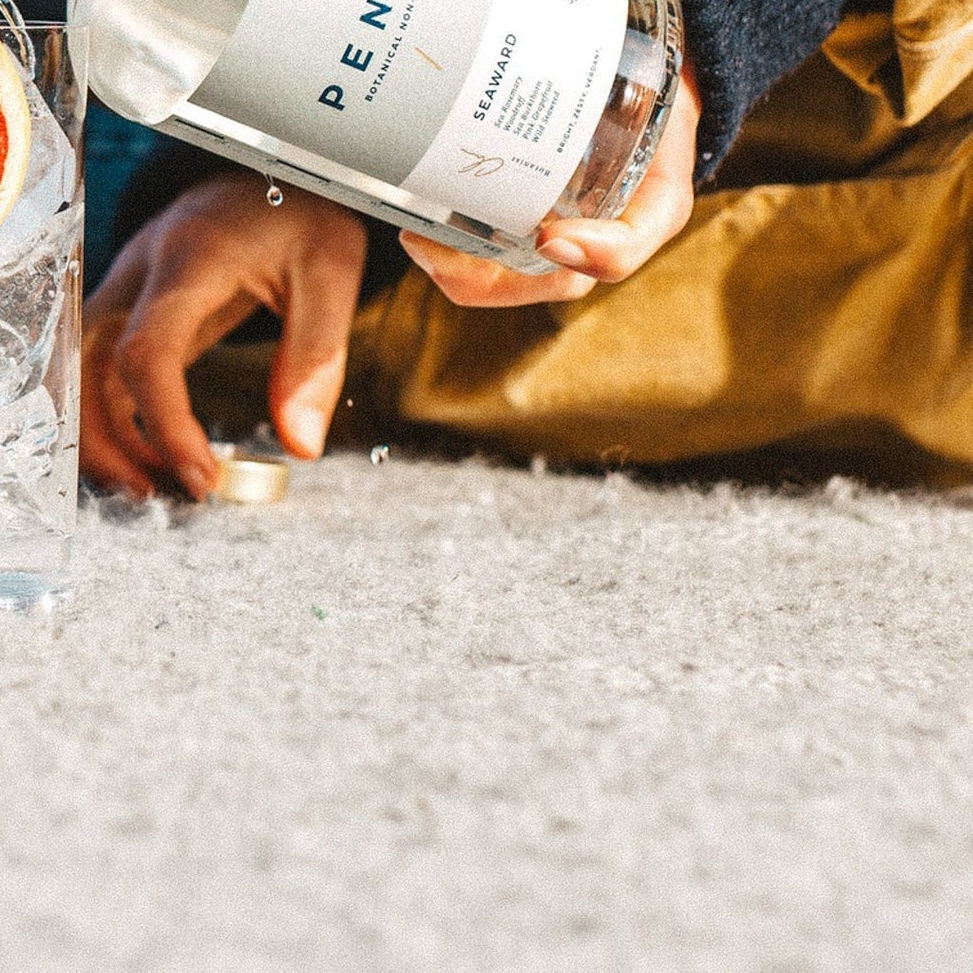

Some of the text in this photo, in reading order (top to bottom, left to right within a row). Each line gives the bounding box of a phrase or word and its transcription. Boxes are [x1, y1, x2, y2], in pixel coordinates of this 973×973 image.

[365, 36, 402, 102] BOTANICAL
[474, 33, 516, 121] SEAWARD
[494, 76, 523, 128] Sea Rosemary
[503, 94, 526, 131] Woodruff
[513, 80, 543, 136] Sea Buckthorn
[522, 80, 553, 140] Pink Grapefruit
[531, 90, 560, 143] Wild Seaweed
[557, 121, 577, 153] BRIGHT,
